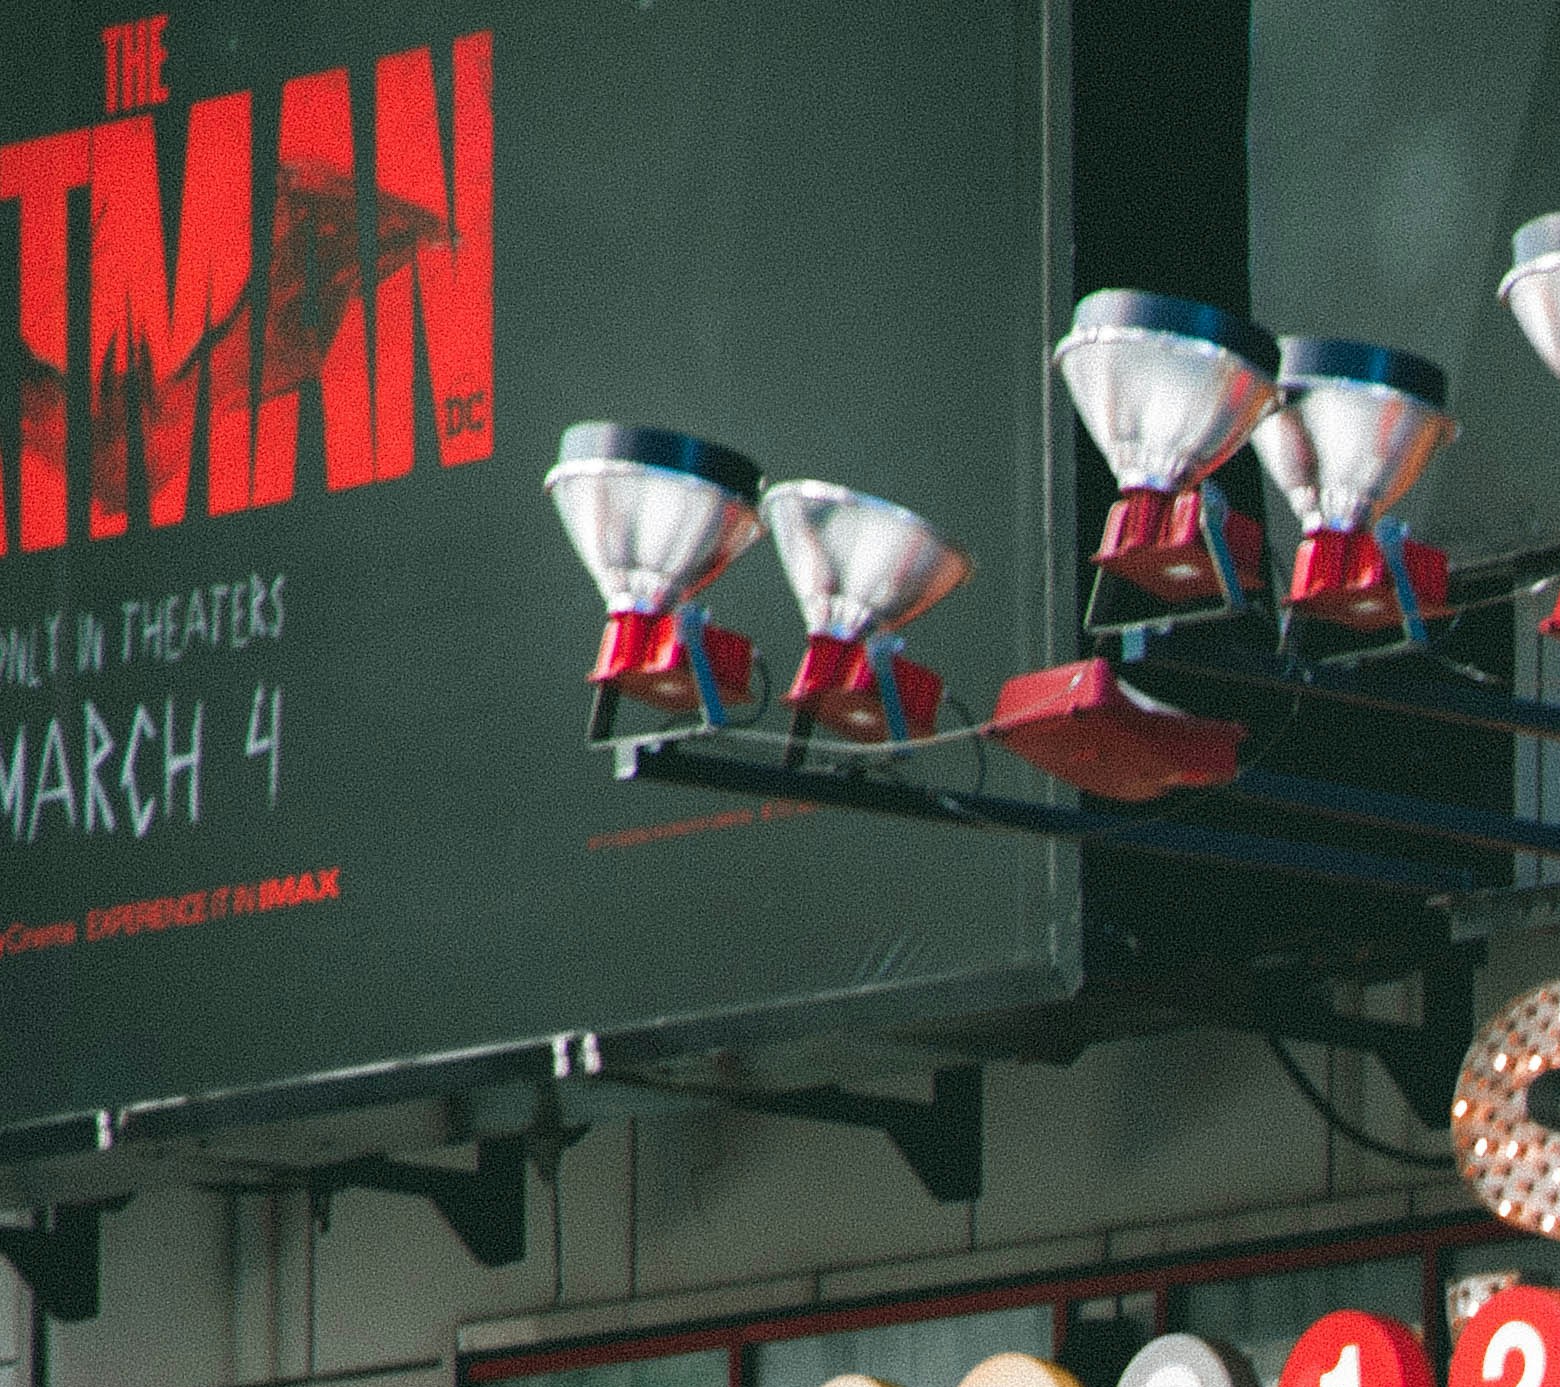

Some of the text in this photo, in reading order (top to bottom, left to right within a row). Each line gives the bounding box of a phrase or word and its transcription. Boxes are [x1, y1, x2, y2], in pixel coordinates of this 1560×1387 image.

[101, 13, 169, 113] THE
[0, 30, 494, 554] TMAN
[445, 391, 487, 437] DC
[0, 610, 63, 690] NLY
[122, 572, 286, 664] THEATERS
[0, 681, 282, 845] MARCH 4
[257, 866, 341, 912] IMAX
